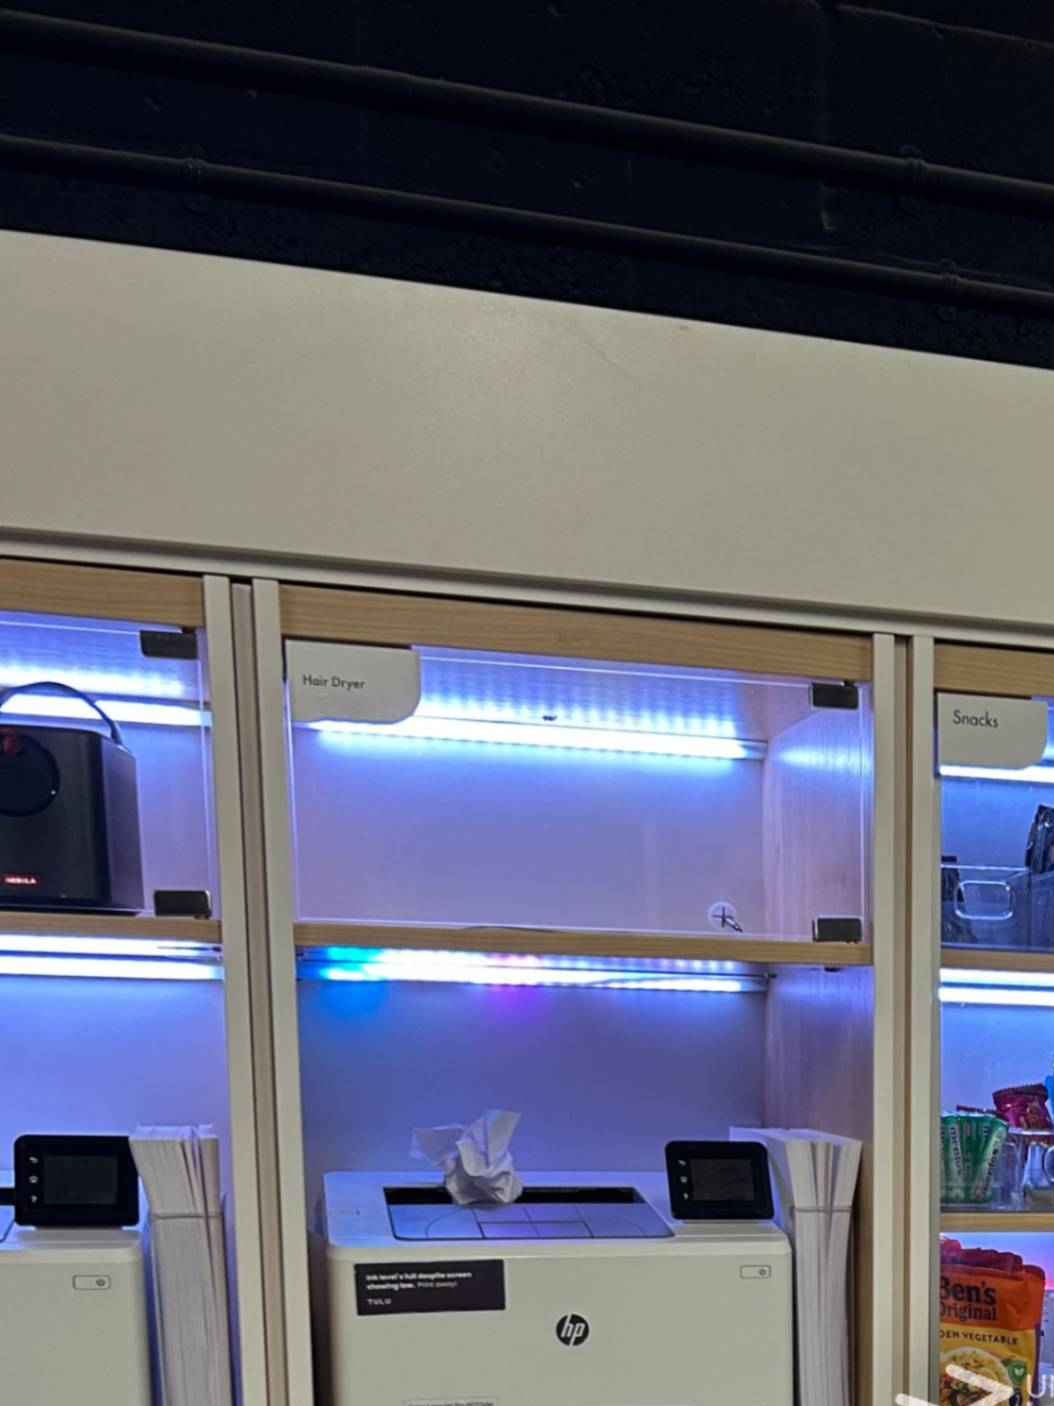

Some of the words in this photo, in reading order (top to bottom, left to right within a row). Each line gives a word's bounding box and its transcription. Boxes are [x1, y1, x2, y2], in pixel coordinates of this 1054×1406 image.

[302, 674, 328, 687] Hair
[331, 676, 366, 691] Dryer
[953, 709, 999, 729] Snacks
[560, 1313, 586, 1347] hp
[962, 1331, 1018, 1345] VEGETABLE
